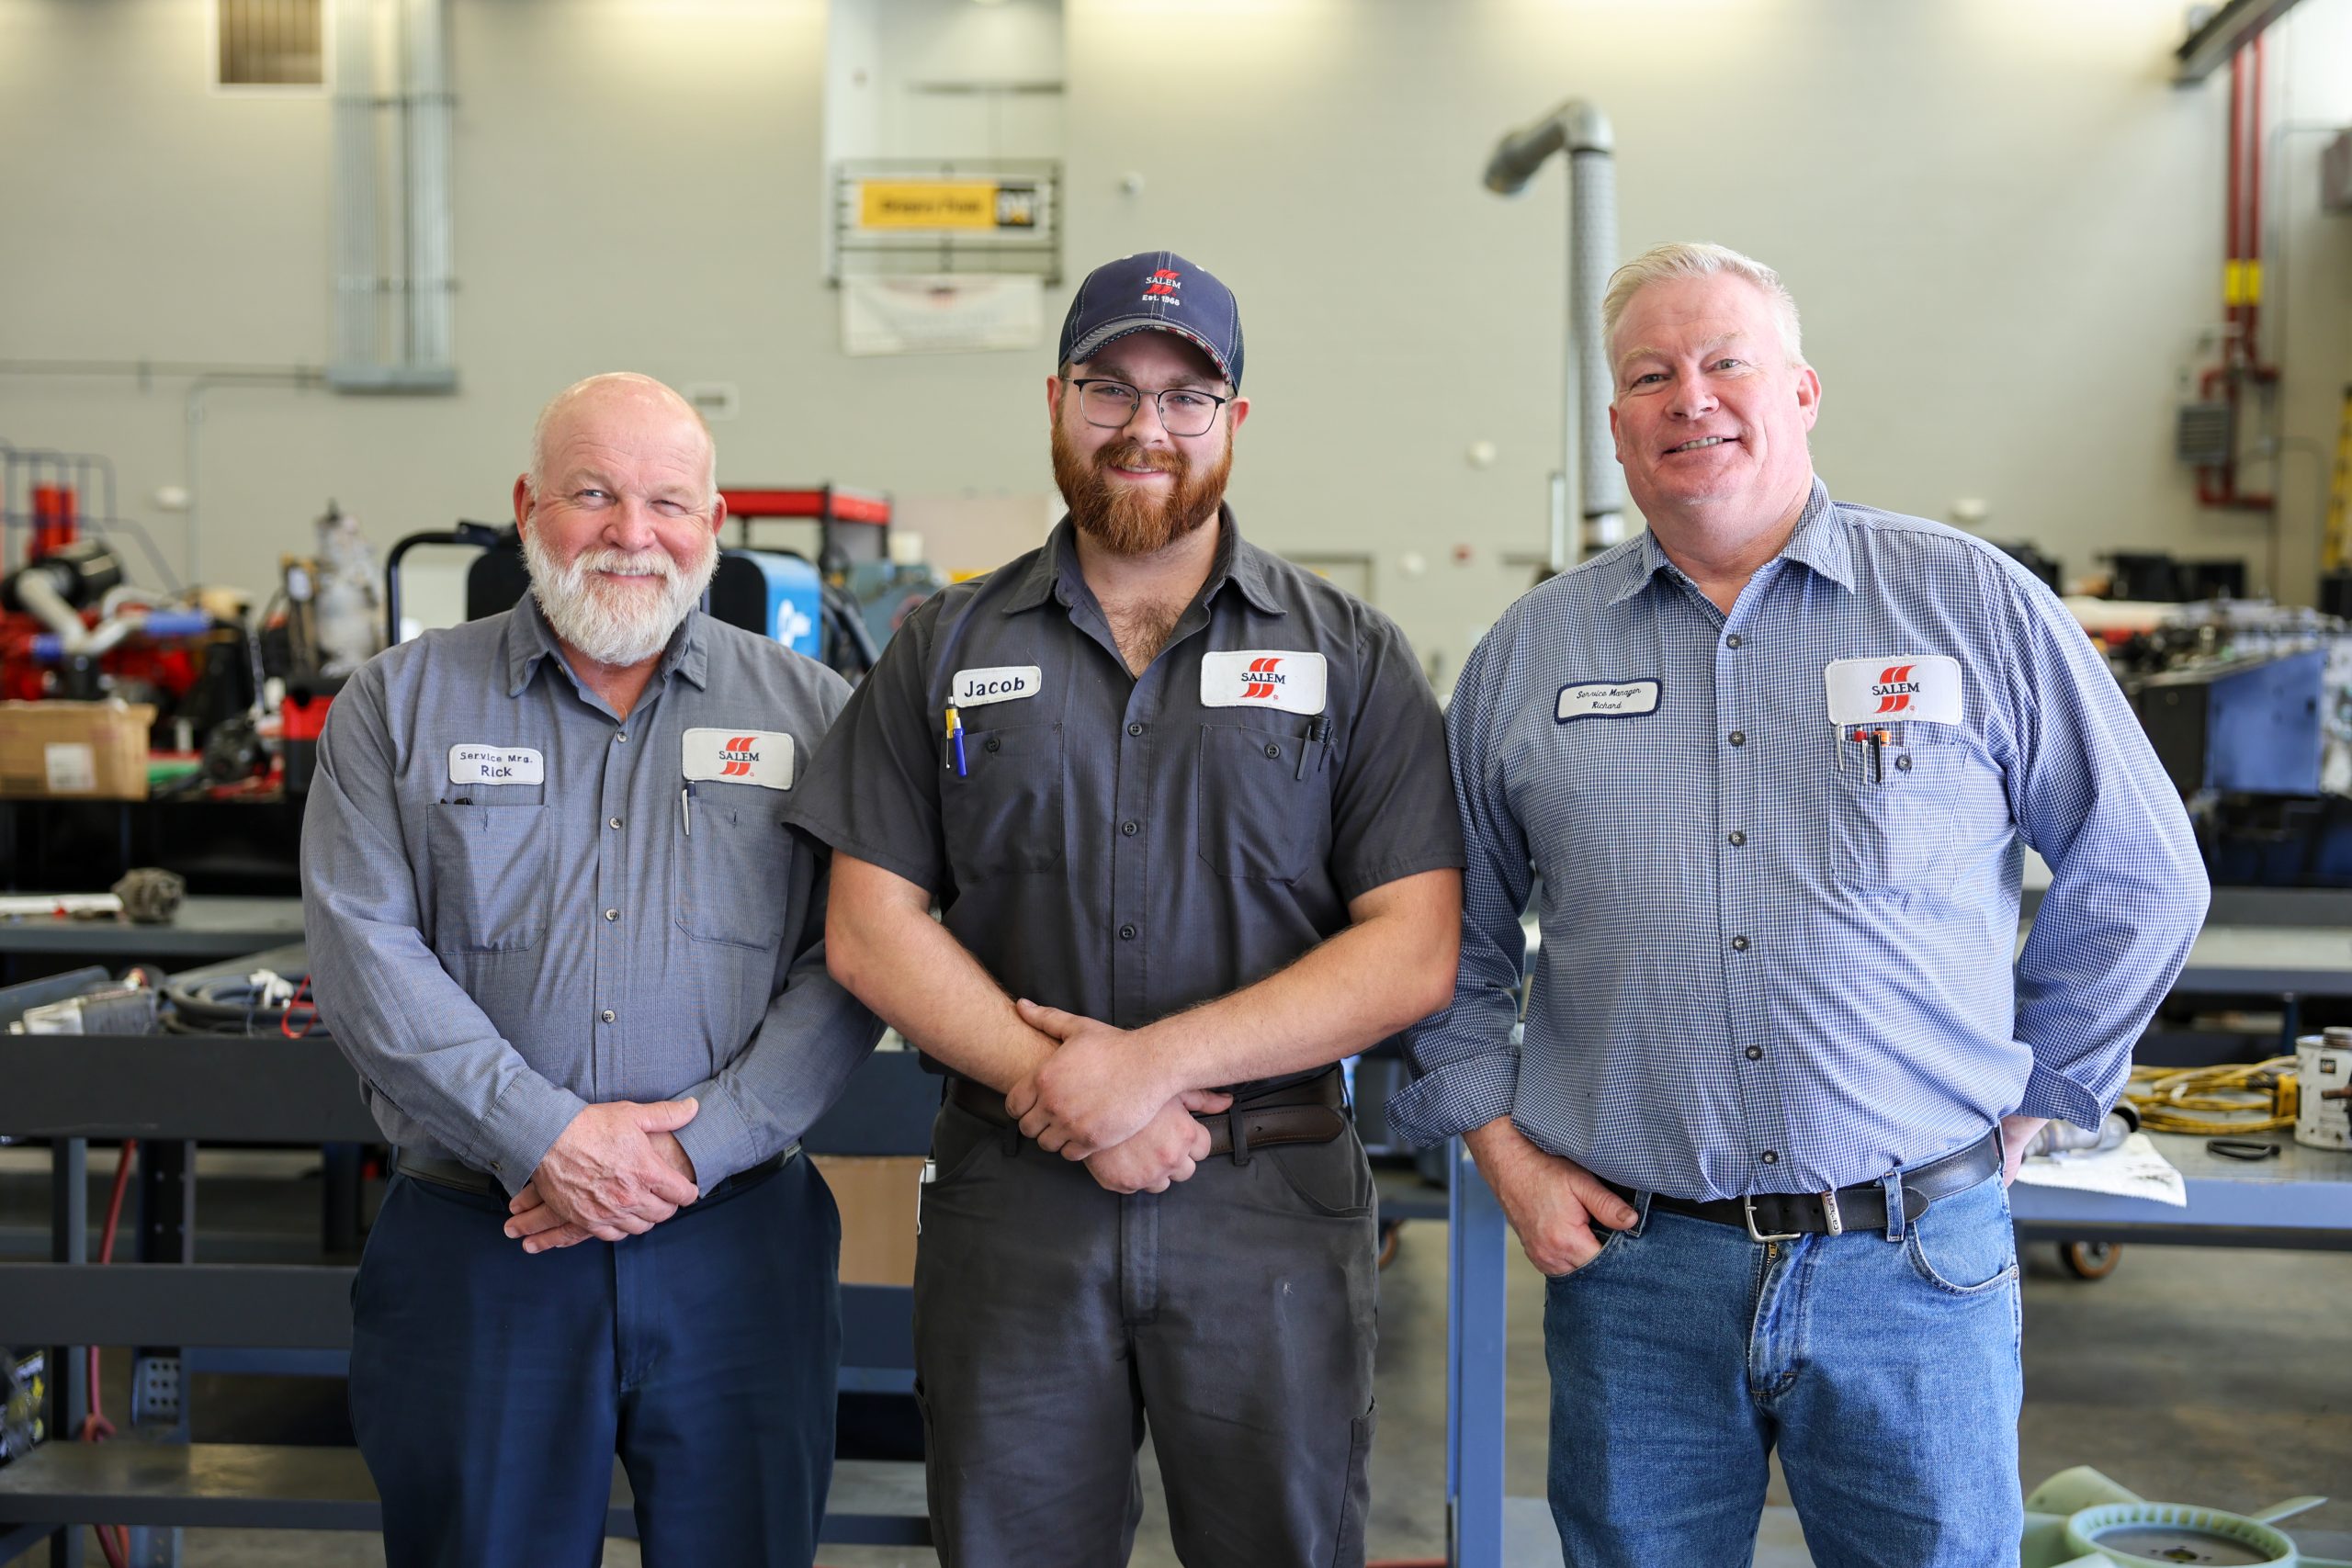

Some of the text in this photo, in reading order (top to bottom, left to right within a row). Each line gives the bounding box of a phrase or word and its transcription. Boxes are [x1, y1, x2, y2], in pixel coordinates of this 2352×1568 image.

[1146, 276, 1182, 289] SALEM
[1241, 672, 1286, 684] SALEM
[965, 677, 1025, 697] Jacob
[1609, 688, 1642, 697] Manager
[1871, 682, 1920, 696] SALEM
[1592, 701, 1623, 709] Richard
[460, 752, 502, 761] Service
[719, 750, 760, 761] SALEM
[481, 765, 512, 777] Rick
